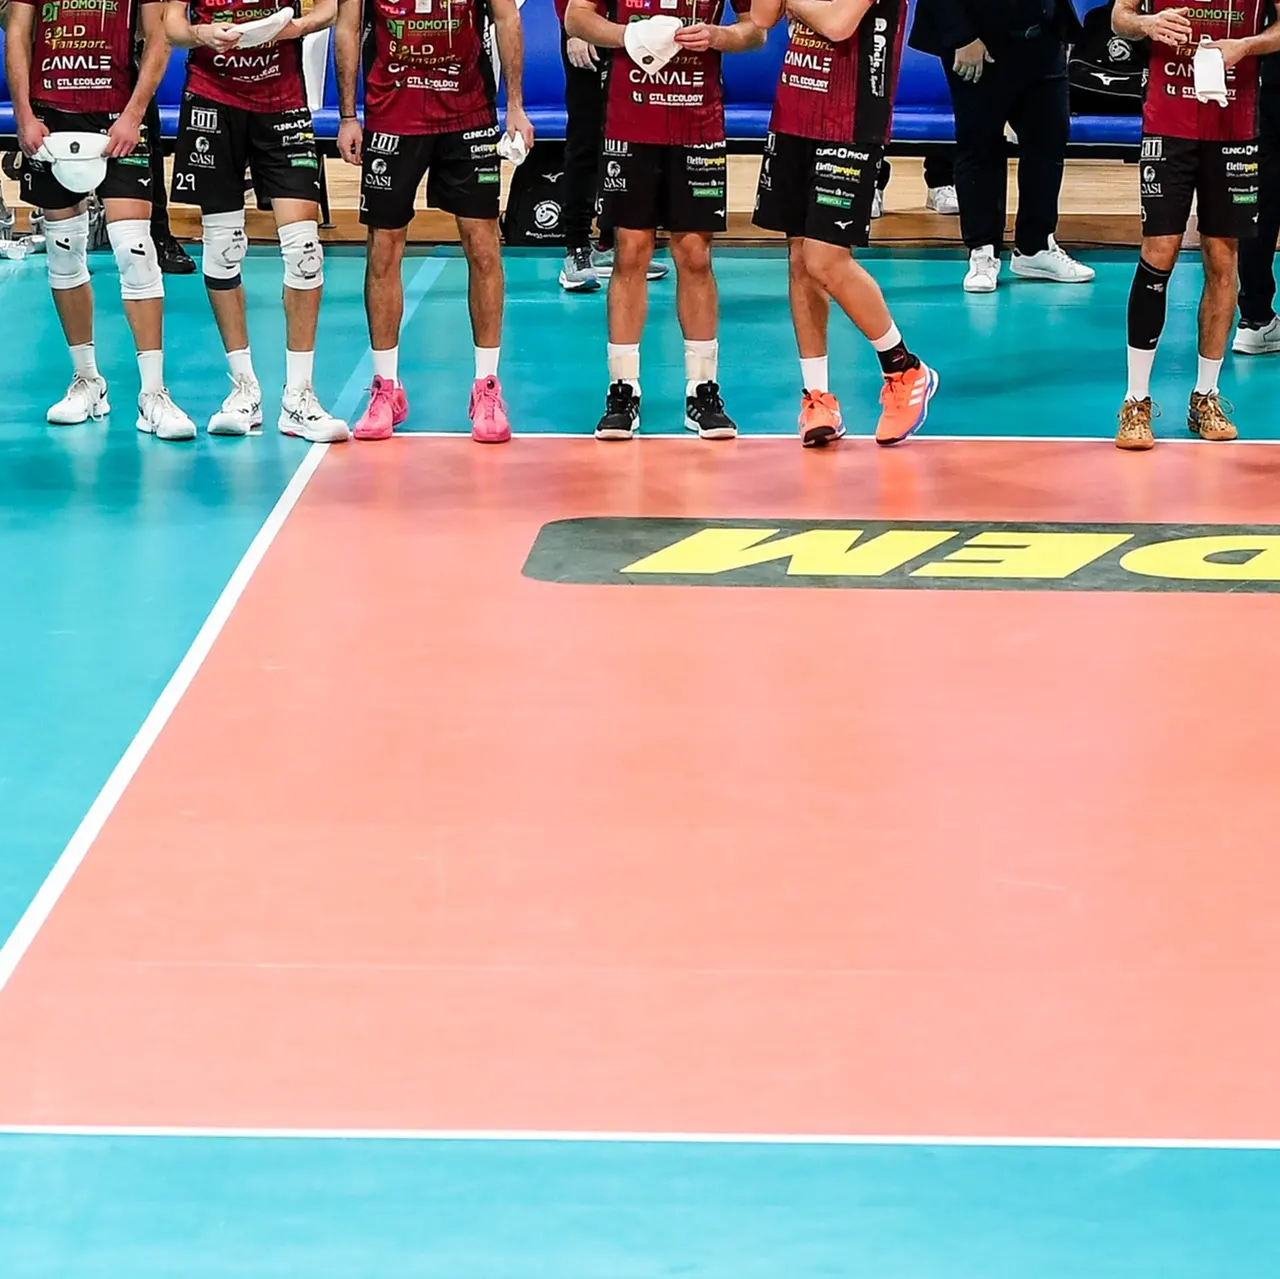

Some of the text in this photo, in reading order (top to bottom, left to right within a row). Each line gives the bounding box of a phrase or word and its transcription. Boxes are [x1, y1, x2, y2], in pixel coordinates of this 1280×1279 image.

[62, 0, 119, 11] DOMOTEK
[1187, 8, 1245, 21] DOMOTEK
[45, 24, 86, 39] GOLD
[42, 55, 112, 71] CANALE
[784, 49, 833, 72] CANALE
[57, 77, 112, 87] CTL ECOLOGY
[629, 69, 705, 85] CANALE
[667, 94, 704, 103] ECOLOGY
[189, 153, 215, 165] OASI
[23, 173, 32, 191] 9
[176, 172, 196, 191] 29
[365, 174, 392, 187] OASI
[604, 177, 626, 189] OASI
